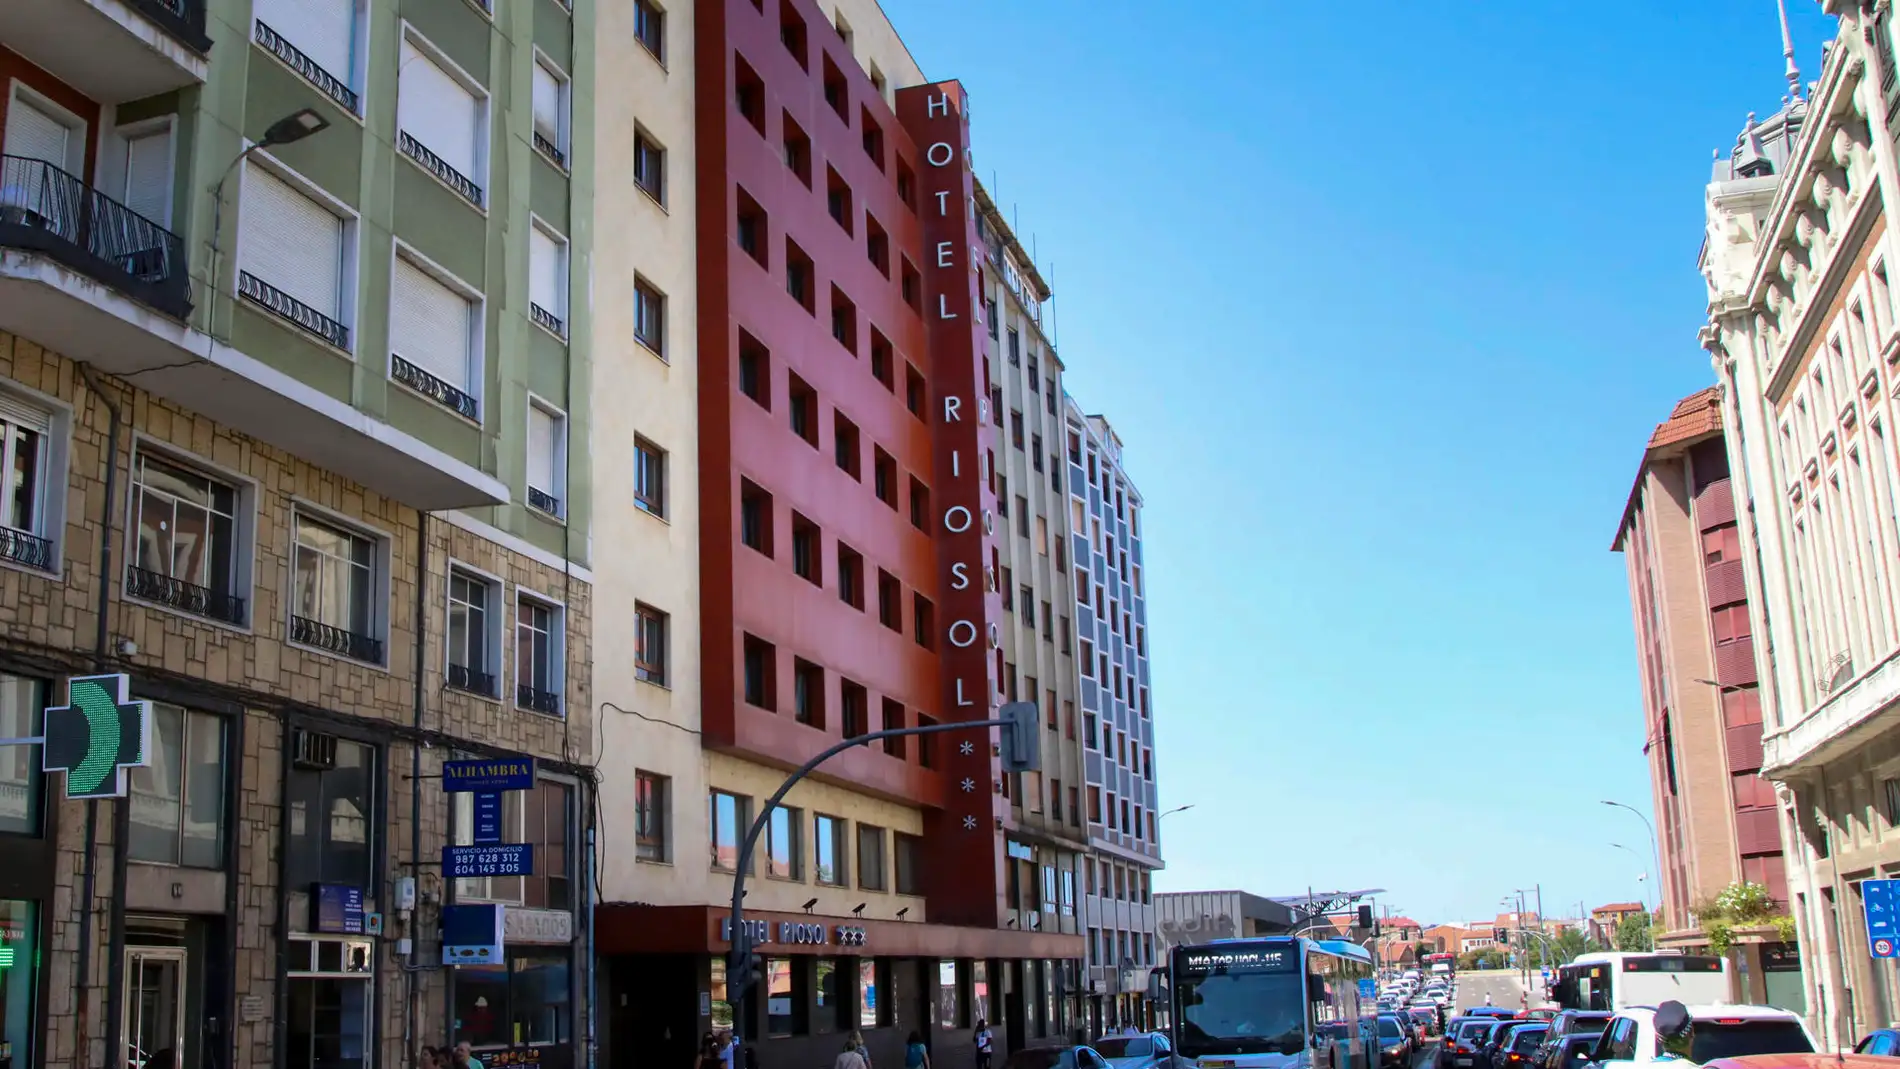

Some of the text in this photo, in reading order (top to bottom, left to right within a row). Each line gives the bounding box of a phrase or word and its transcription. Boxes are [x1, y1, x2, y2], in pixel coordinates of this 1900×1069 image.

[927, 92, 977, 706] HOTEL RIOSOL
[448, 764, 528, 778] ALHAMBRA
[455, 853, 519, 864] 987 628 312
[455, 863, 519, 874] 604 145 305
